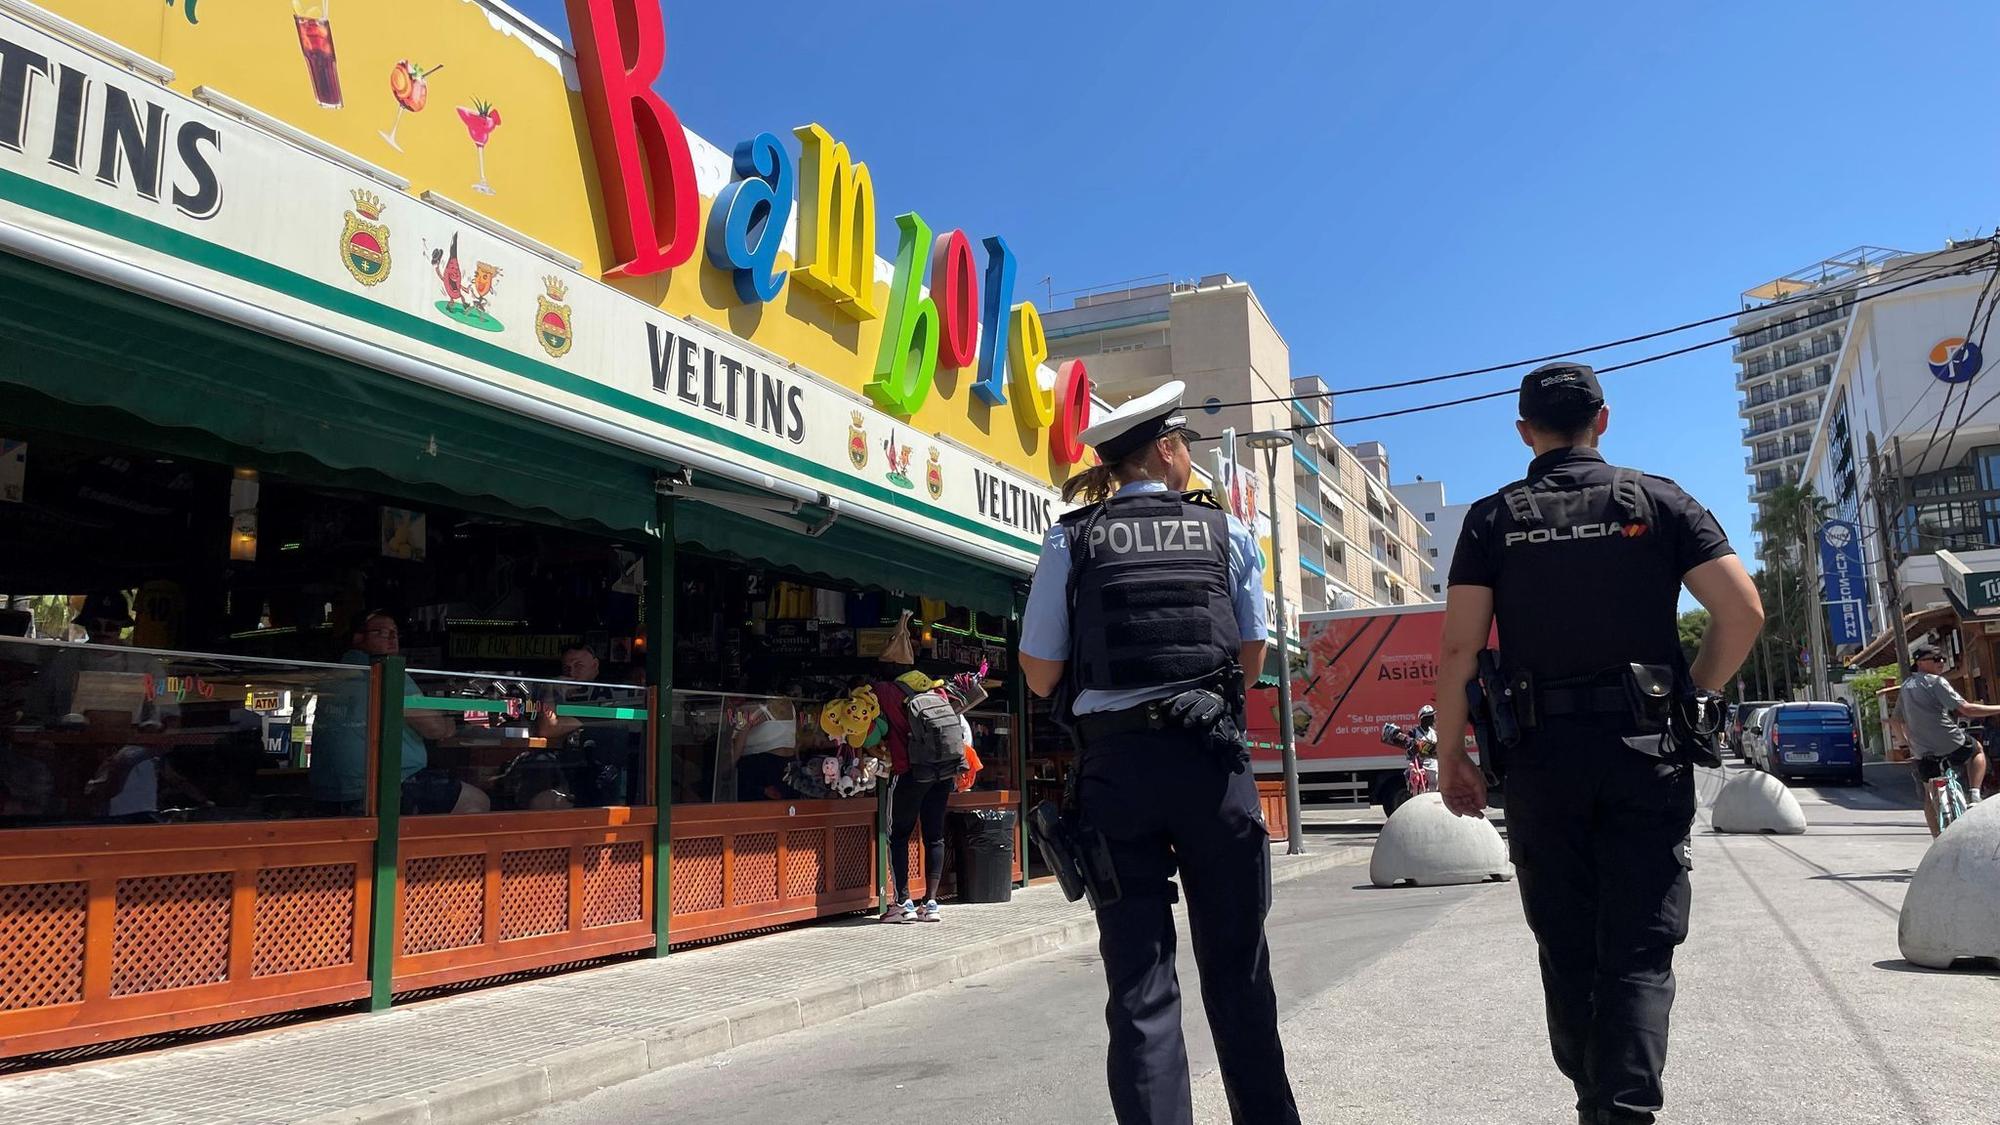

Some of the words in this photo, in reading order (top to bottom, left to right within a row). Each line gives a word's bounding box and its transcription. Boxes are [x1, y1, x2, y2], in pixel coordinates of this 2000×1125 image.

[566, 0, 1091, 465] Bamboleo
[646, 321, 806, 445] VELTINS
[973, 467, 1052, 536] VELTINS
[1088, 520, 1213, 560] POLIZEI
[1504, 520, 1624, 547] POLICIA
[255, 697, 278, 710] ATM
